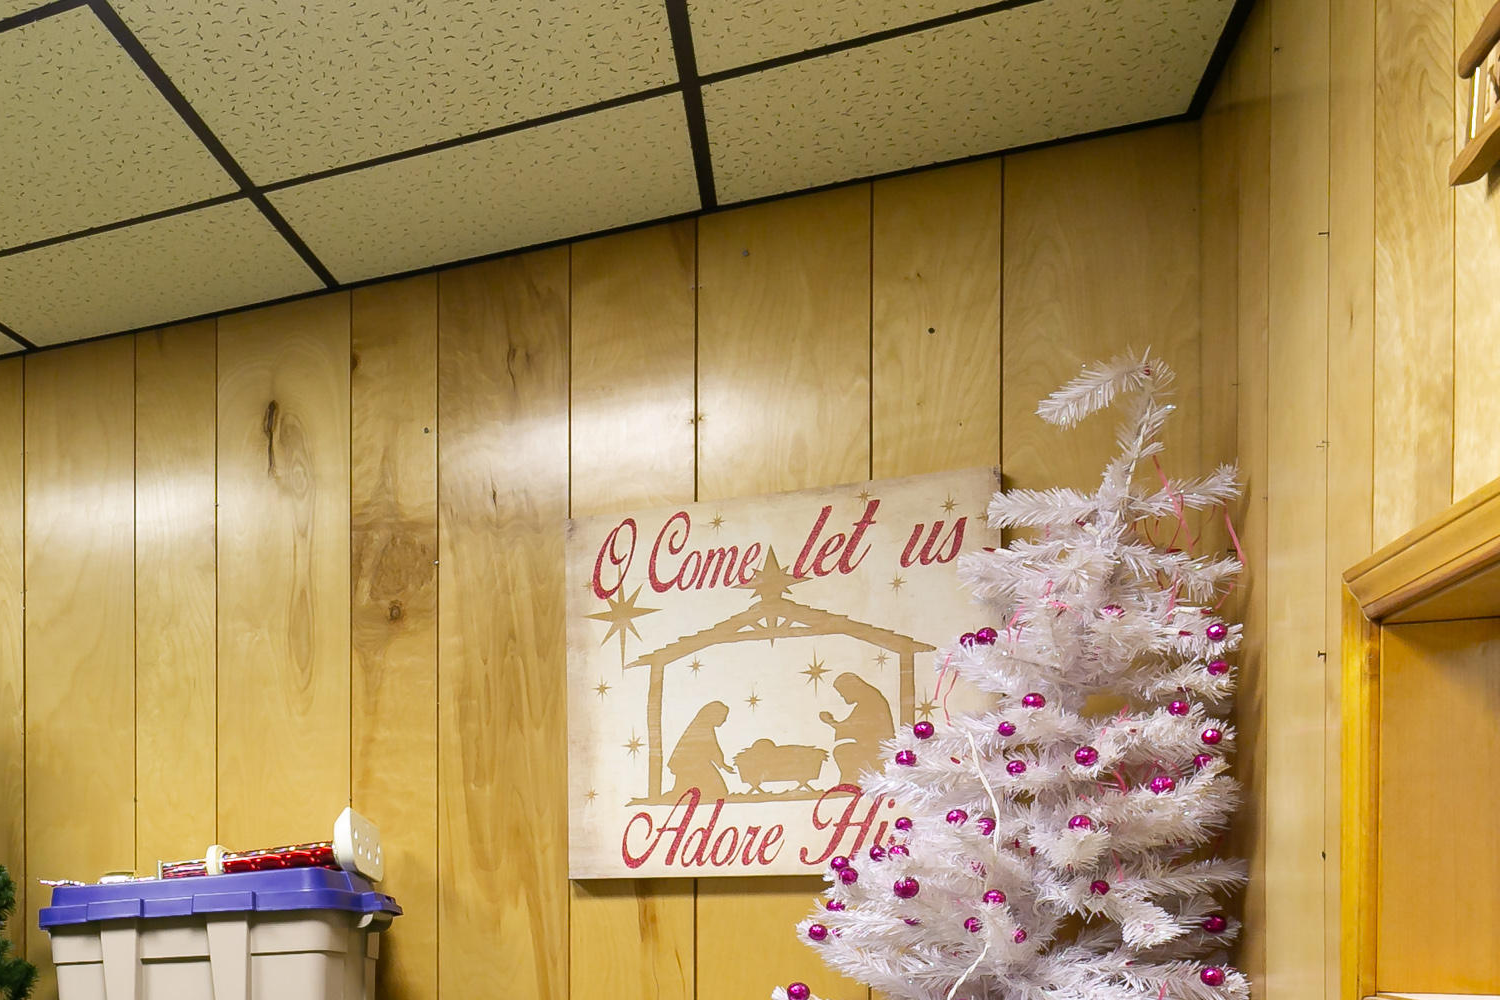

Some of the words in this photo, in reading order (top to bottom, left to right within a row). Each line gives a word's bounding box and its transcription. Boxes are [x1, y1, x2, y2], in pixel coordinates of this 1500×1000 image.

[592, 517, 638, 600] O
[648, 511, 762, 593] Come
[792, 499, 880, 579] let
[900, 516, 967, 568] us
[622, 787, 785, 869] Adore
[799, 783, 912, 866] Hi
